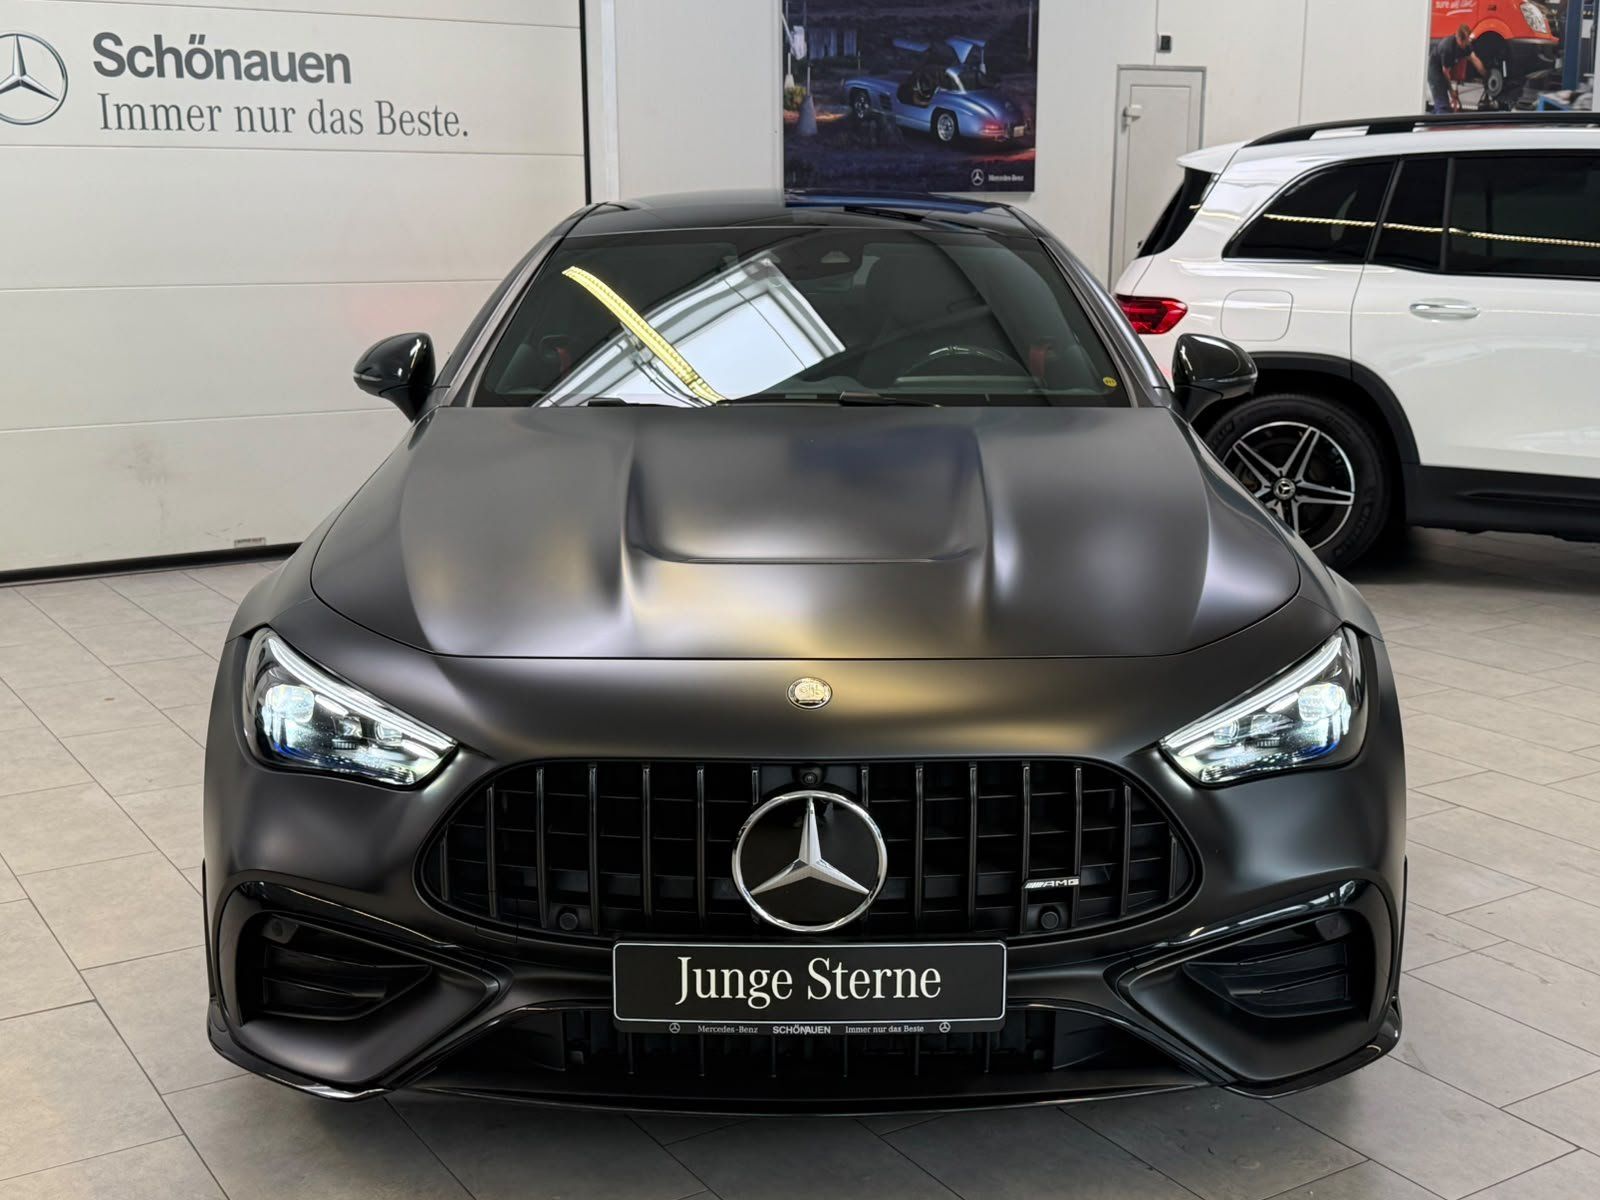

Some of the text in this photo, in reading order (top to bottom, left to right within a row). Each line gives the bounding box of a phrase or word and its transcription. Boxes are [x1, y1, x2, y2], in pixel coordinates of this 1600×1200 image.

[93, 31, 352, 84] Schönauen
[97, 92, 469, 138] Immer nur das Beste.
[1042, 878, 1079, 888] AMG
[675, 956, 941, 1009] Junge Sterne
[697, 1025, 759, 1034] Mercedes-Benz
[772, 1024, 831, 1036] SCHÖNAUEN
[845, 1025, 872, 1034] Immer
[888, 1025, 902, 1033] das
[903, 1025, 925, 1033] Beste
